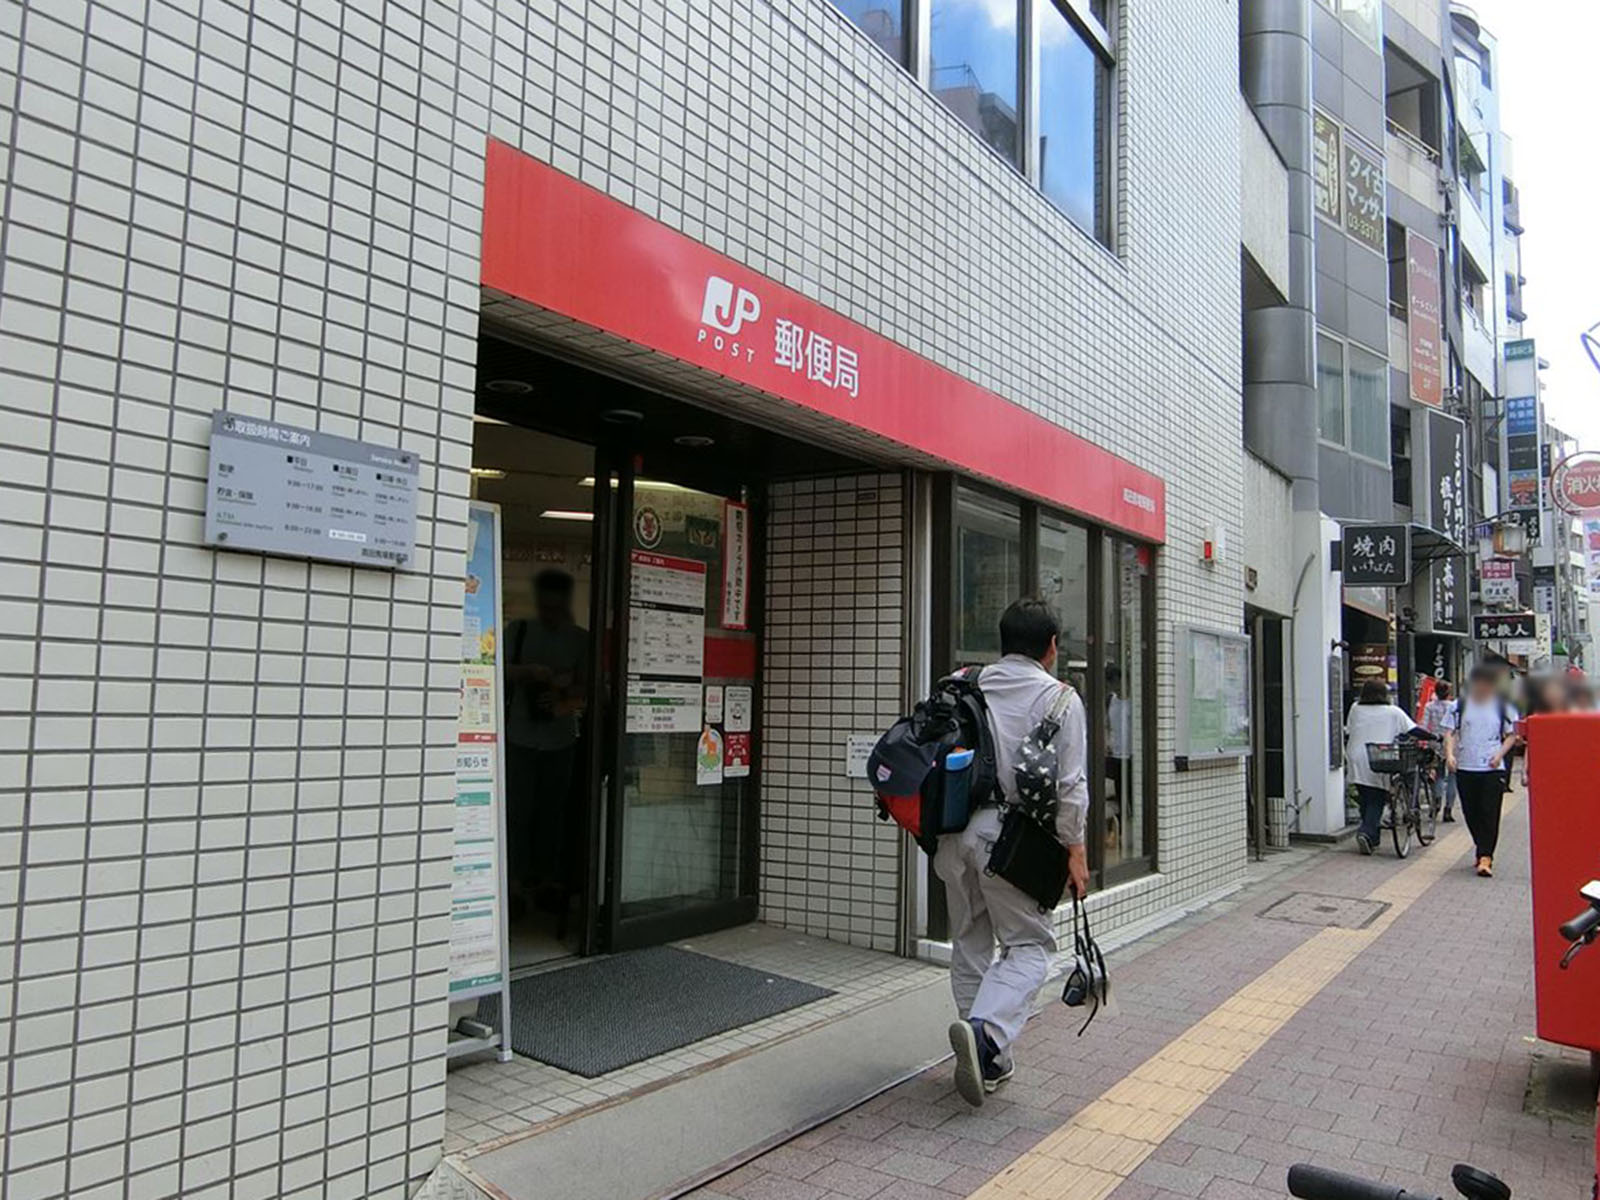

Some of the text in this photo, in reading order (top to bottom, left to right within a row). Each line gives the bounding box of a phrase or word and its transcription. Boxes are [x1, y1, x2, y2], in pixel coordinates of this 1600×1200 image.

[1346, 182, 1385, 220] マッサ
[701, 275, 761, 335] JP
[698, 329, 755, 363] POST
[774, 317, 859, 398] 郵便局
[1352, 535, 1396, 558] 焼肉
